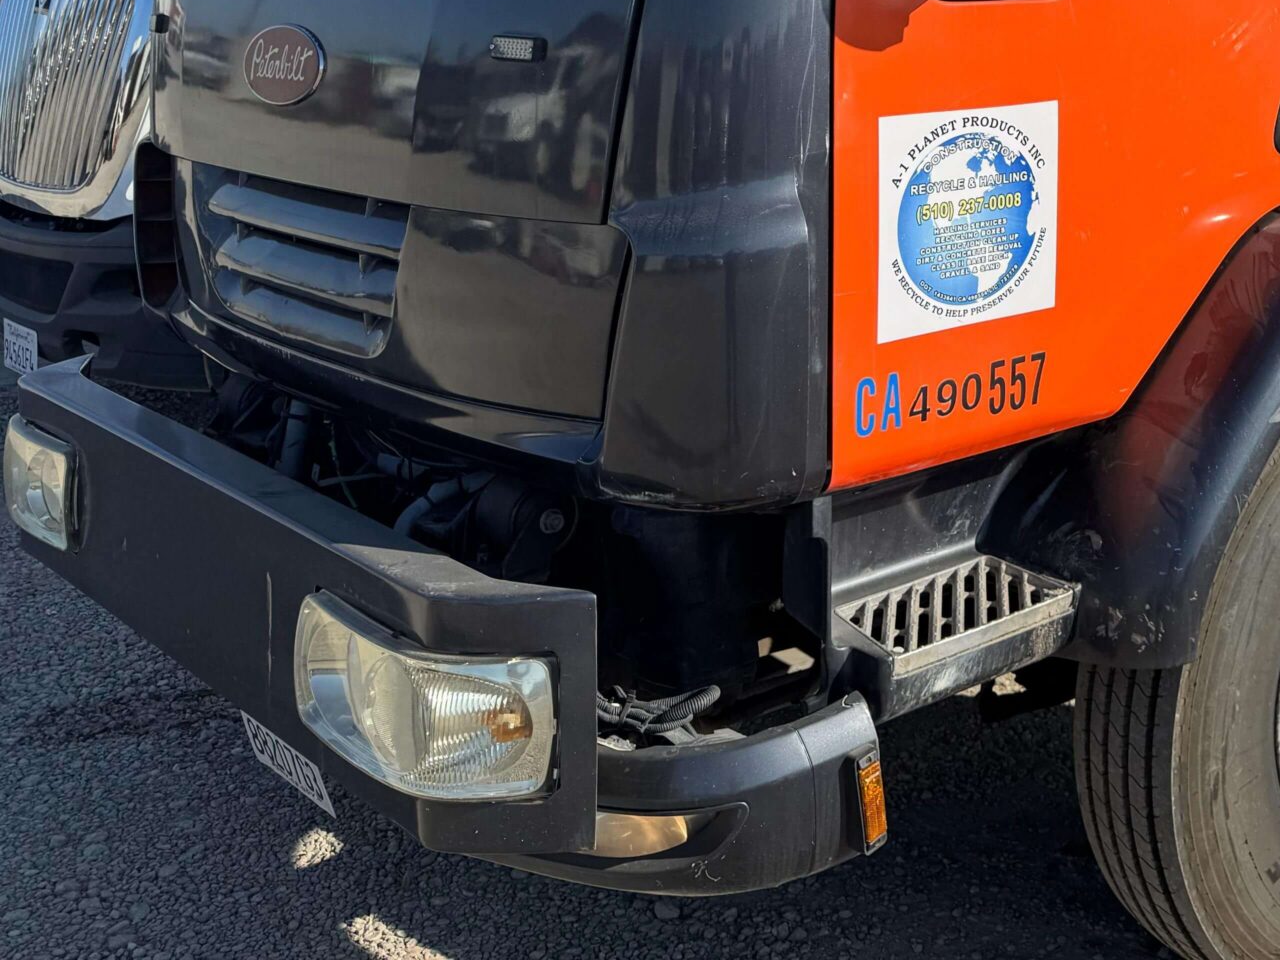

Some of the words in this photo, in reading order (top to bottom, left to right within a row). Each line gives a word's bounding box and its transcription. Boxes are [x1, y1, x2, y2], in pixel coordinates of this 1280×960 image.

[249, 38, 313, 81] Peterbilt
[891, 163, 909, 189] A-1
[907, 120, 957, 161] PLANET
[962, 116, 1029, 146] PRODUCTS
[1028, 144, 1046, 169] INC
[923, 138, 1018, 174] CONSTRUCTION
[910, 178, 965, 196] RECYCLE
[967, 177, 976, 189] &
[979, 171, 1028, 188] HAULING
[916, 201, 954, 225] (510)
[958, 192, 1022, 216] 237-0008
[934, 224, 968, 235] HAULING
[970, 217, 1007, 230] SERVICES
[935, 231, 979, 245] RECYCLING
[981, 227, 1006, 237] BOXES
[916, 255, 935, 266] DIRT
[945, 247, 987, 260] CONCRETE
[987, 241, 1022, 254] REMOVAL
[920, 240, 981, 256] CONSTRUCTION
[983, 235, 1007, 245] CLEAN
[891, 259, 902, 277] WE
[898, 275, 931, 310] RECYCLE
[932, 305, 944, 316] TO
[945, 309, 969, 318] HELP
[971, 286, 1015, 316] PRESERVE
[1014, 267, 1030, 288] OUR
[1028, 227, 1047, 267] FUTURE
[931, 261, 957, 272] CLASS
[940, 268, 970, 280] GRAVEL
[980, 262, 1001, 273] SAND
[855, 371, 902, 438] CA
[908, 351, 1047, 423] 490557
